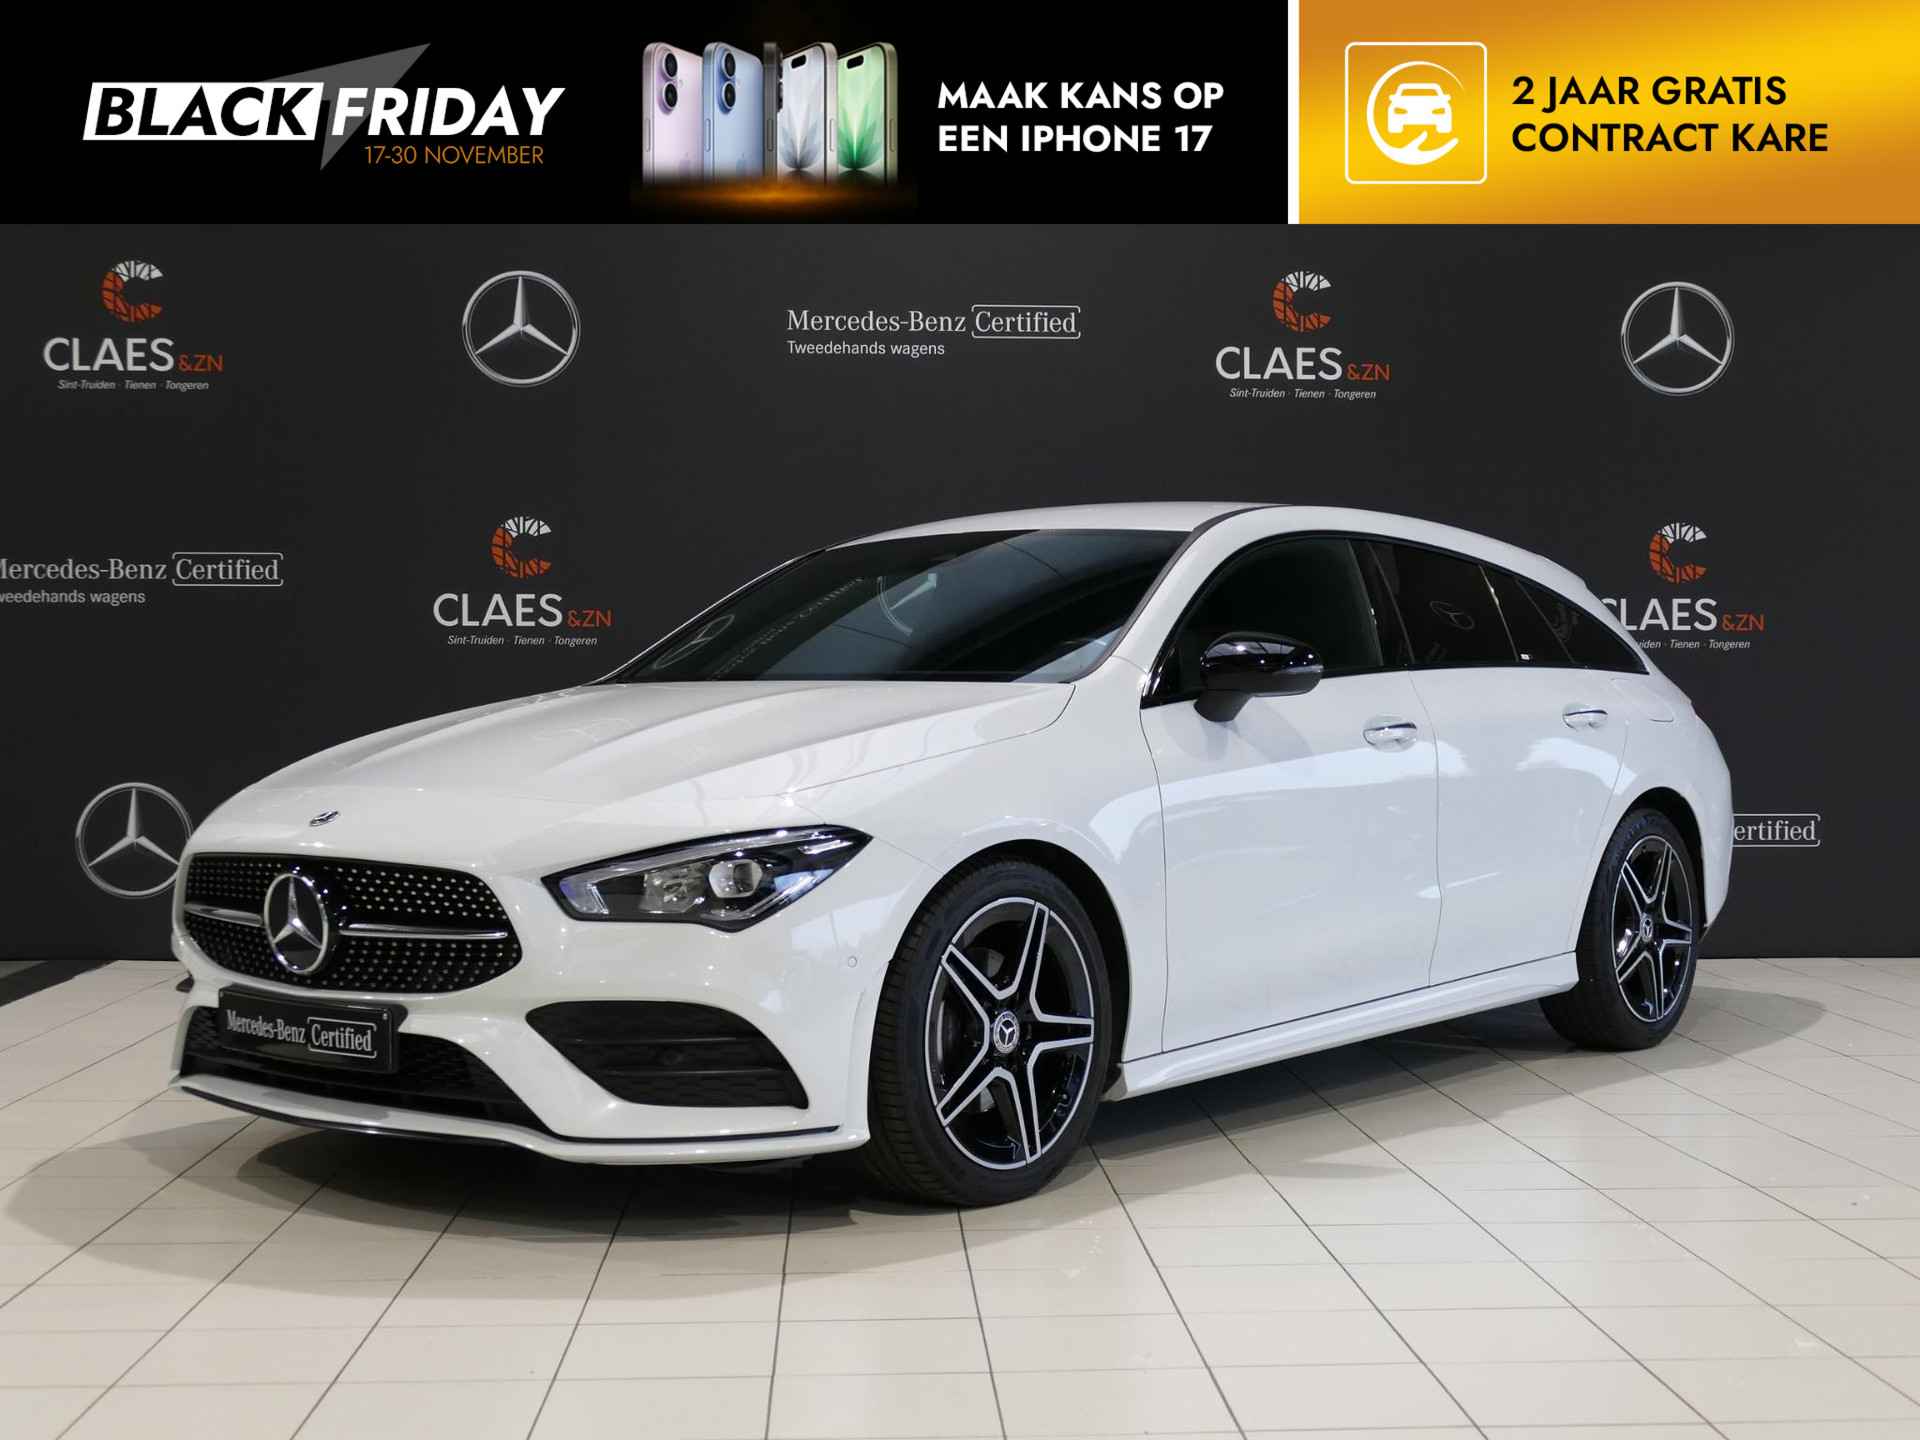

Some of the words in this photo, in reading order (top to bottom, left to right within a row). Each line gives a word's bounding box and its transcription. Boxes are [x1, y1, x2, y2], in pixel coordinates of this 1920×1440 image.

[786, 309, 967, 333] Mercedes-Benz
[974, 310, 1077, 334] Certified
[42, 336, 175, 372] CLAES
[178, 354, 224, 372] &ZN
[786, 339, 887, 355] Tweedehands
[890, 343, 945, 359] wagens
[1215, 346, 1343, 381] CLAES
[1346, 362, 1390, 382] &ZN
[57, 379, 116, 390] Sint-Truiden
[124, 379, 157, 390] Tienen
[165, 379, 210, 393] Tongeren
[1229, 387, 1286, 399] Sint-Truiden
[1294, 388, 1326, 399] Tienen
[1334, 388, 1377, 401] Tongeren
[175, 558, 280, 580] Certified
[89, 592, 146, 607] wagens
[432, 592, 564, 628] CLAES
[567, 608, 612, 628] &ZN
[1721, 613, 1765, 632] &ZN
[447, 634, 505, 646] Sint-Truiden
[514, 635, 545, 645] Tienen
[554, 635, 598, 648] Tongeren
[1670, 638, 1700, 649] Tienen
[1709, 639, 1751, 651] Tongeren
[1734, 819, 1817, 841] ertified
[226, 1009, 306, 1044] Mercedes-Benz
[311, 1023, 373, 1051] Certified
